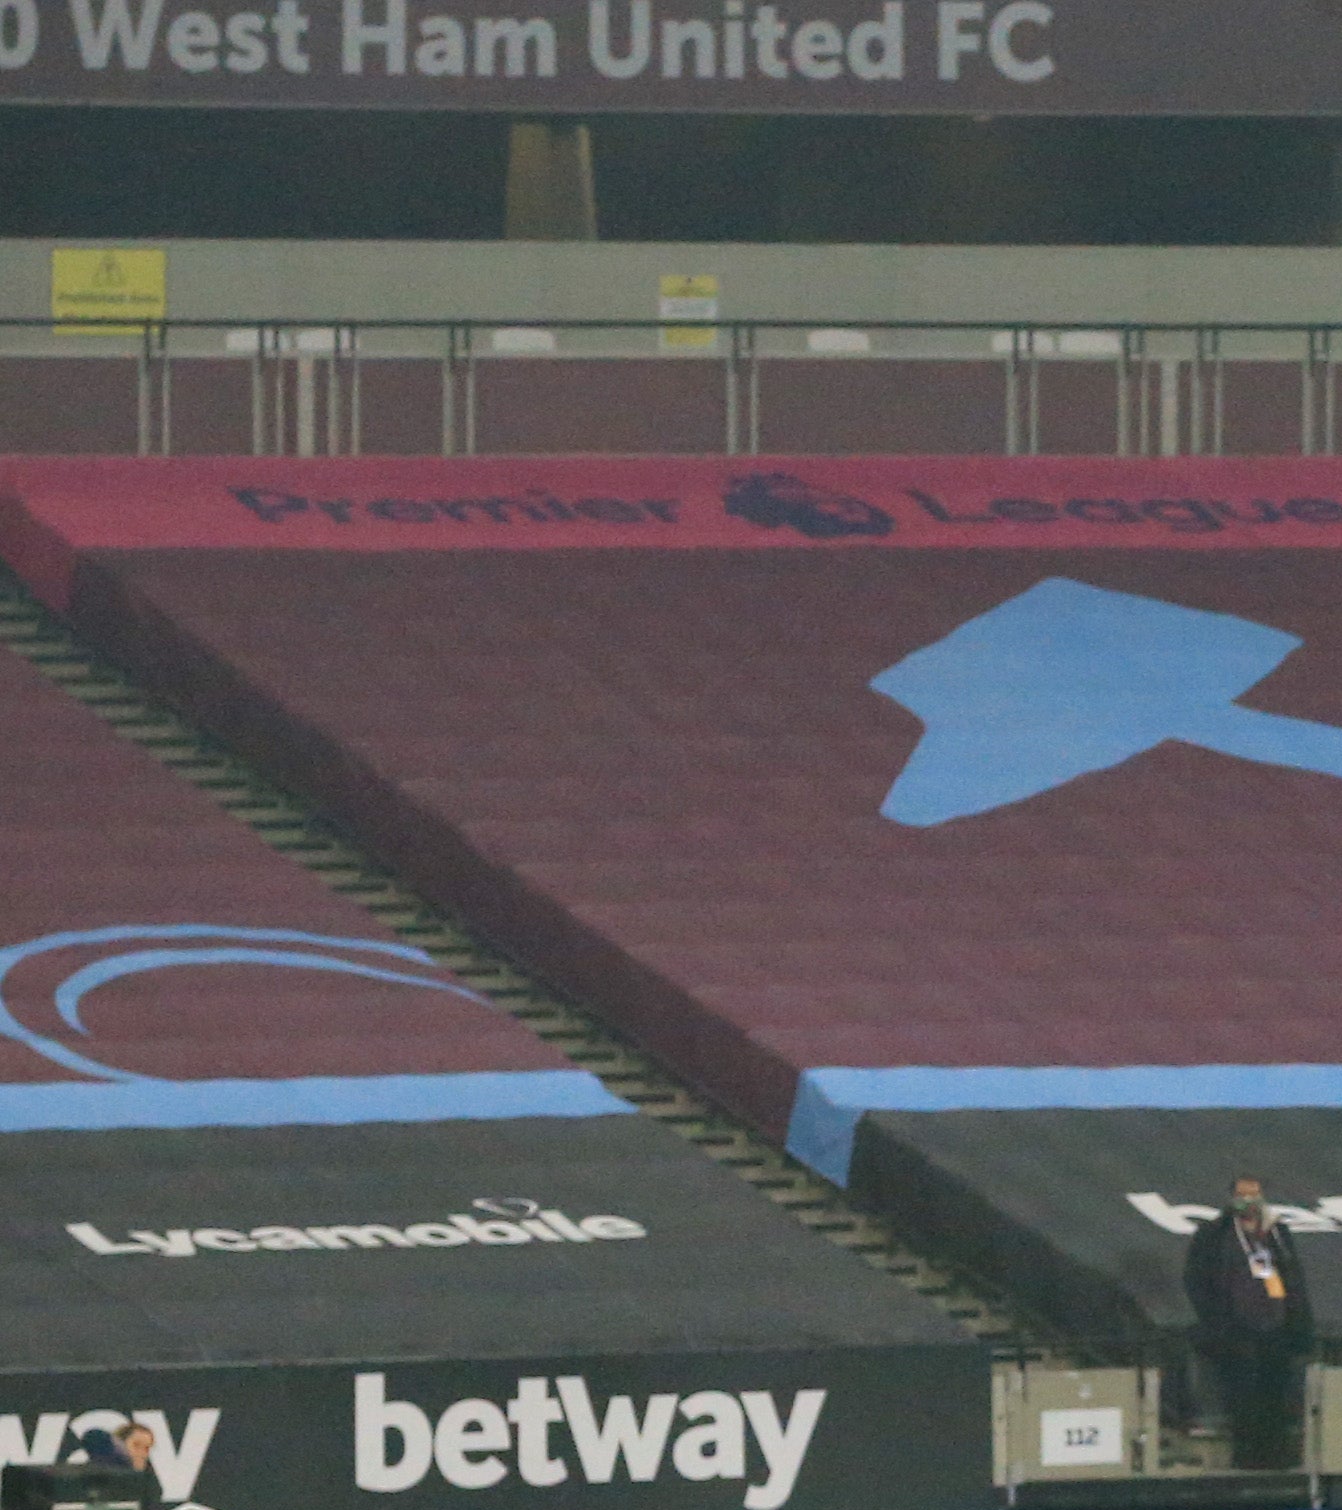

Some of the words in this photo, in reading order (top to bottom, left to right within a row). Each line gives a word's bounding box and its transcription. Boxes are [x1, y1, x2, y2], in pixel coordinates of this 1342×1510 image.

[72, 0, 311, 74] West
[341, 0, 557, 77] Ham
[590, 0, 904, 81] United
[936, 2, 1055, 82] FC
[228, 485, 683, 524] Premier
[65, 1200, 648, 1258] Lycamobile
[1064, 1428, 1099, 1447] 112
